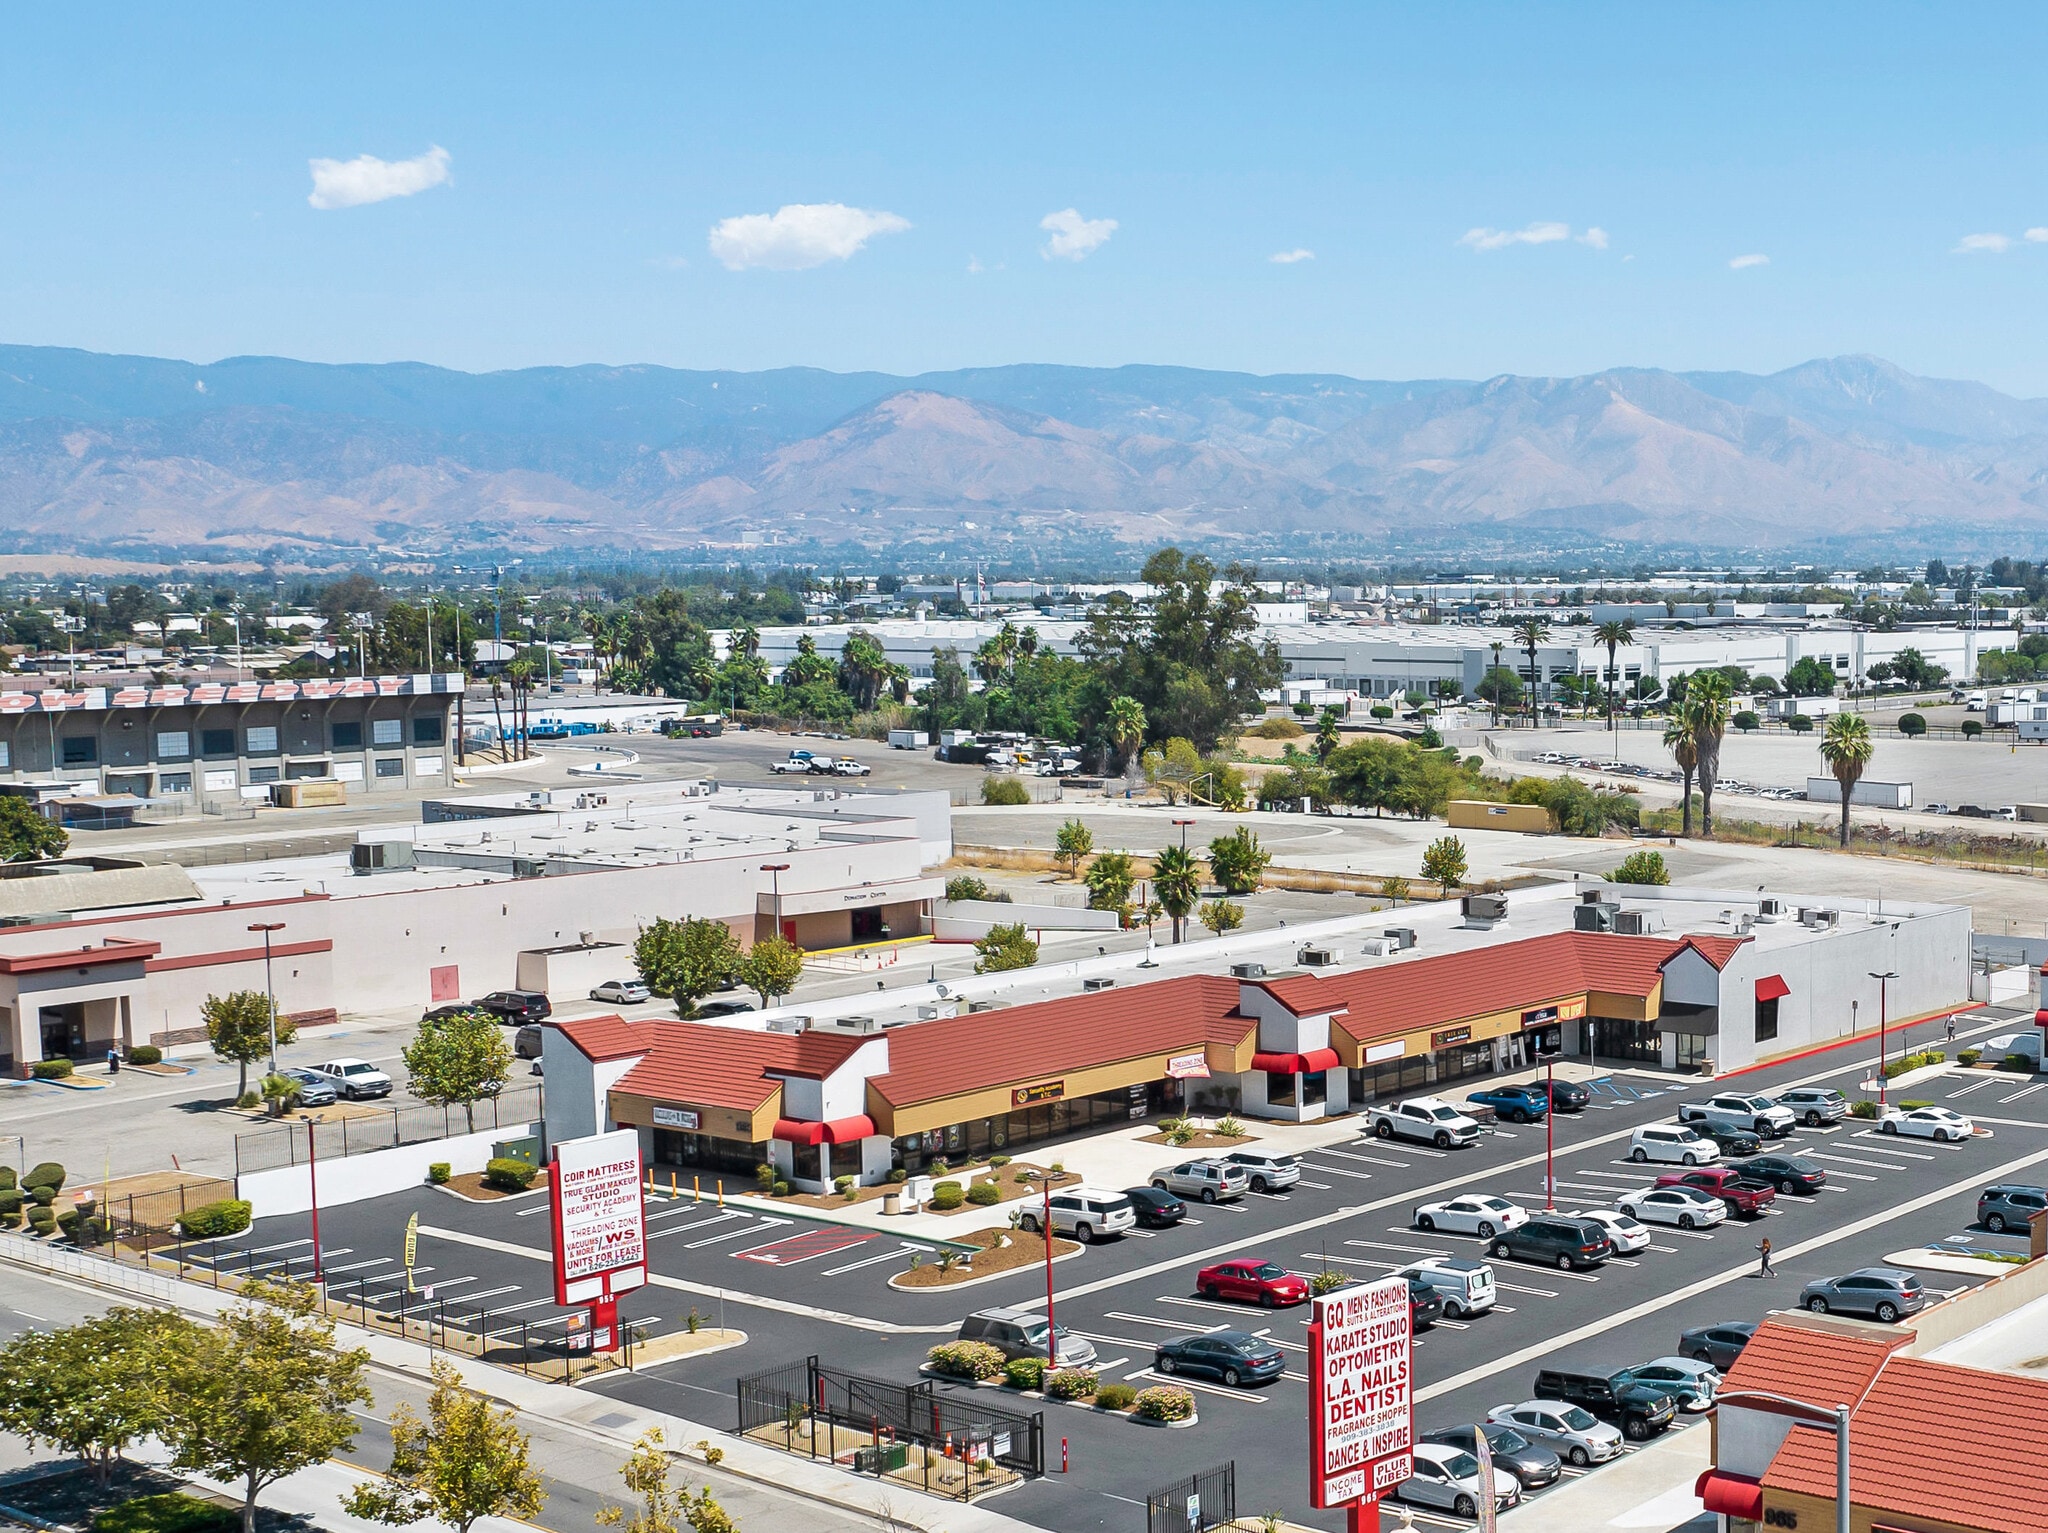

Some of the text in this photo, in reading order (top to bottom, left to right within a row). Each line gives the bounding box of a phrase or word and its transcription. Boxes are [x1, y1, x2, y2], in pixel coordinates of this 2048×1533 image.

[112, 679, 409, 705] SPEEDWAY
[564, 1160, 635, 1183] COIR MATTRESS
[564, 1176, 638, 1199] TRUE GLAM MAKEUP
[582, 1188, 620, 1202] STUDIO
[566, 1194, 637, 1216] SECURITY ACADEMY
[571, 1216, 638, 1239] THREADING ZONE
[605, 1229, 636, 1244] WS
[566, 1237, 599, 1251] VACUUMS
[576, 1246, 595, 1257] MORE
[567, 1244, 642, 1270] UNITS FOR LEASE
[1347, 1283, 1407, 1316] MEN'S FASHIONS
[1327, 1301, 1344, 1330] GQ
[1347, 1302, 1406, 1327] SUITS & ALTERATIONS
[1327, 1317, 1407, 1356] KARATE STUDIO
[1329, 1339, 1406, 1377] OPTOMETRY
[1327, 1360, 1407, 1402] L.A. NAILS
[1331, 1382, 1406, 1424] DENTIST
[1327, 1404, 1407, 1440] FRAGRANCE SHOPPE
[1328, 1426, 1408, 1471] DANCE & INSPIRE
[1376, 1467, 1409, 1486] VIBES
[1377, 1458, 1406, 1476] PLUR
[1328, 1473, 1363, 1494] INCOME
[1337, 1487, 1354, 1498] TAX
[1361, 1491, 1377, 1506] 965
